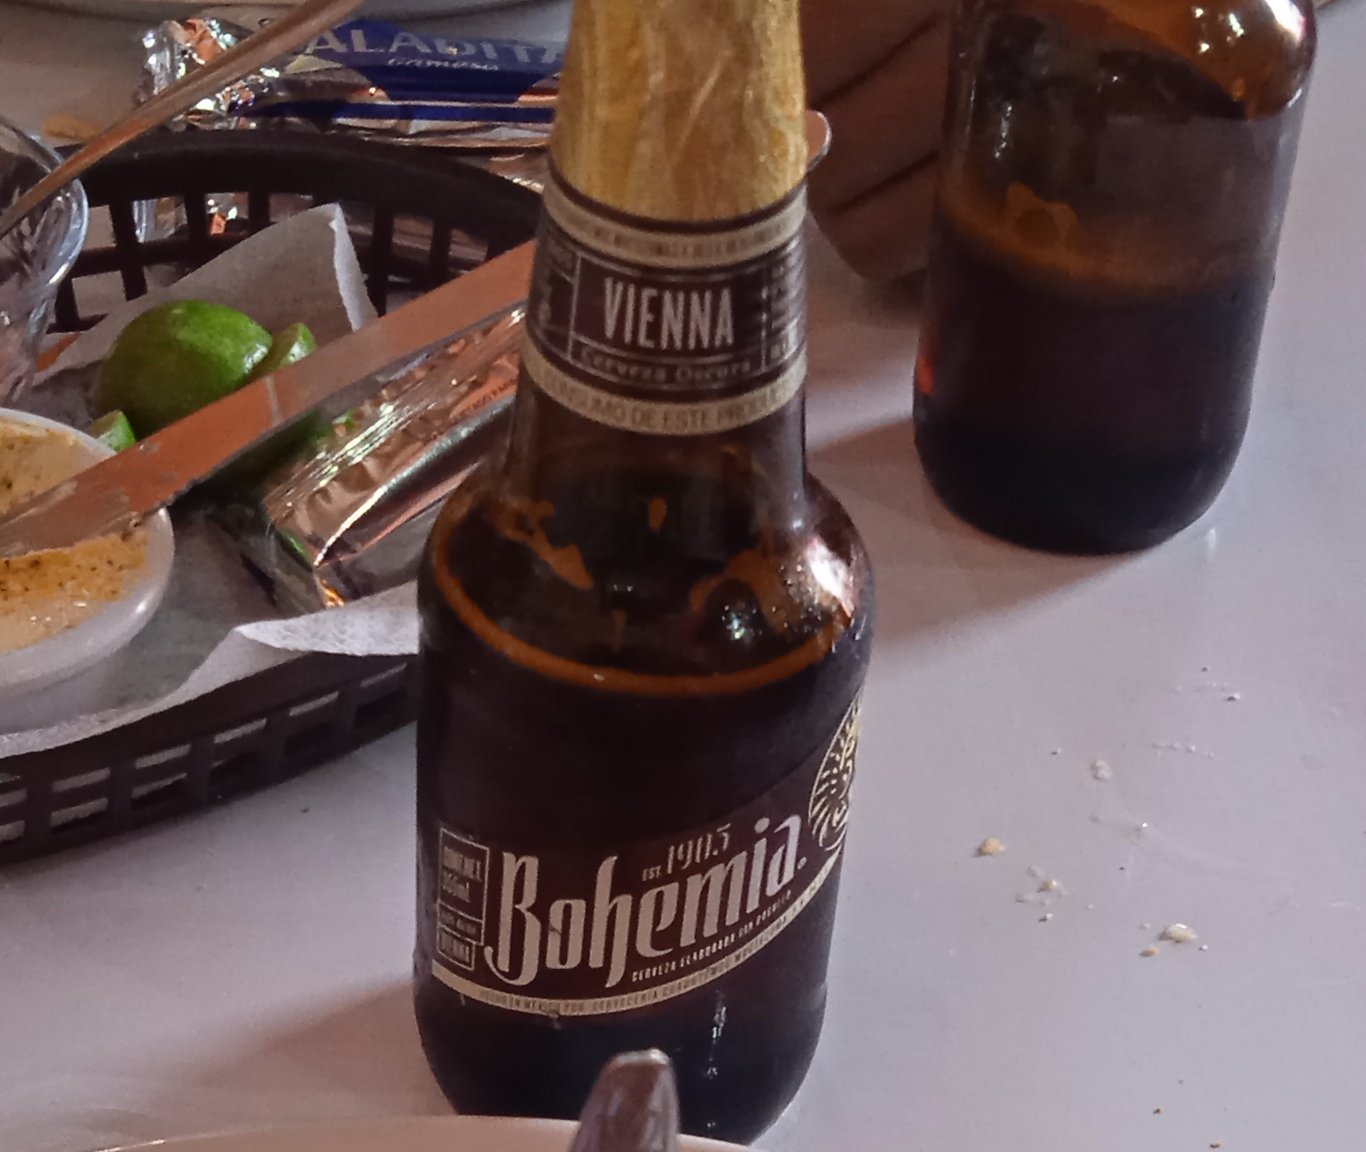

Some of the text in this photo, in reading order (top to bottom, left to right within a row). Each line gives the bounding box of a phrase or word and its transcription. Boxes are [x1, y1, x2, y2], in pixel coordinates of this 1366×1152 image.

[603, 277, 734, 351] VIENNA
[667, 822, 732, 875] 1905
[484, 814, 802, 988] Bohemia
